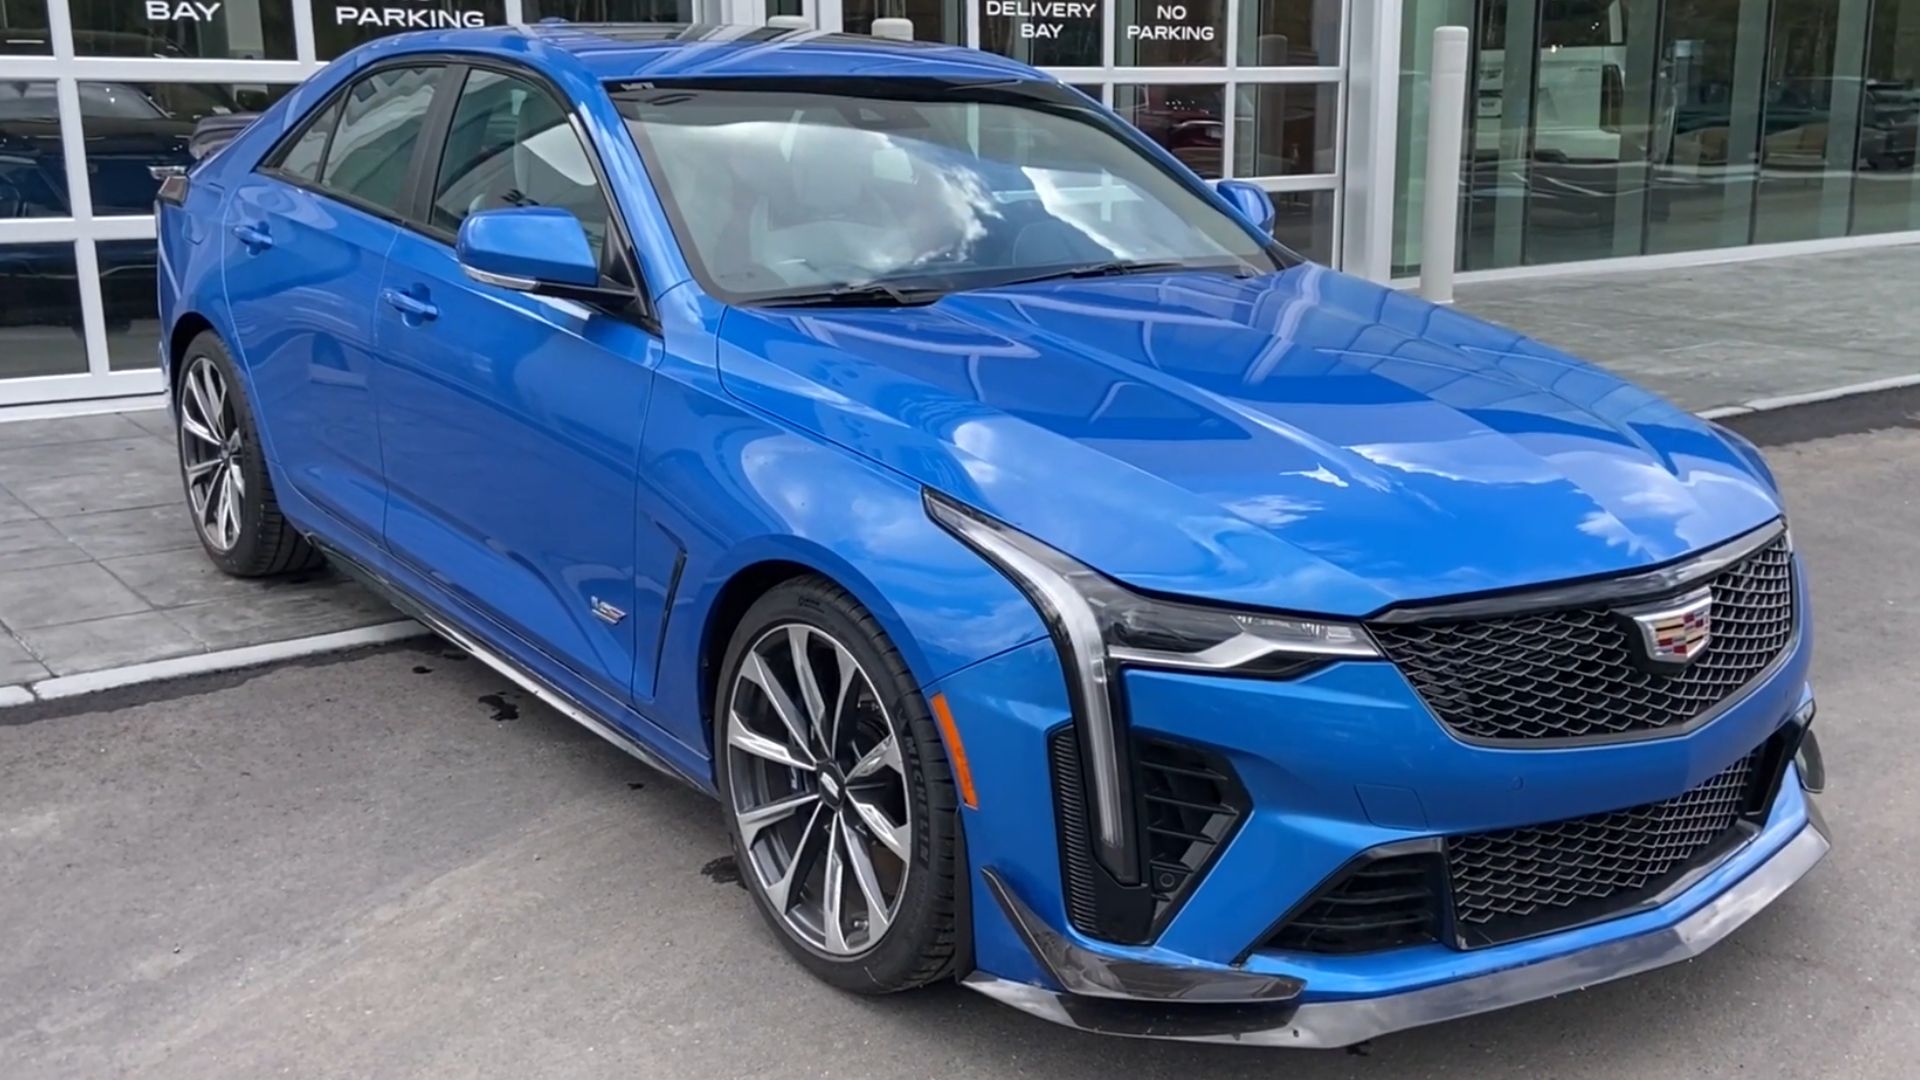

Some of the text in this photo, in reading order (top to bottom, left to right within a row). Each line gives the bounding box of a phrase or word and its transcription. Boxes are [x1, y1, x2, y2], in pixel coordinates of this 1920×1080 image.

[146, 0, 221, 21] BAY
[335, 6, 485, 28] PARKING
[986, 0, 1096, 18] DELIVERY
[1157, 5, 1187, 20] NO
[1020, 23, 1064, 39] BAY
[1127, 25, 1214, 41] PARKING
[904, 736, 929, 865] MICHELIN
